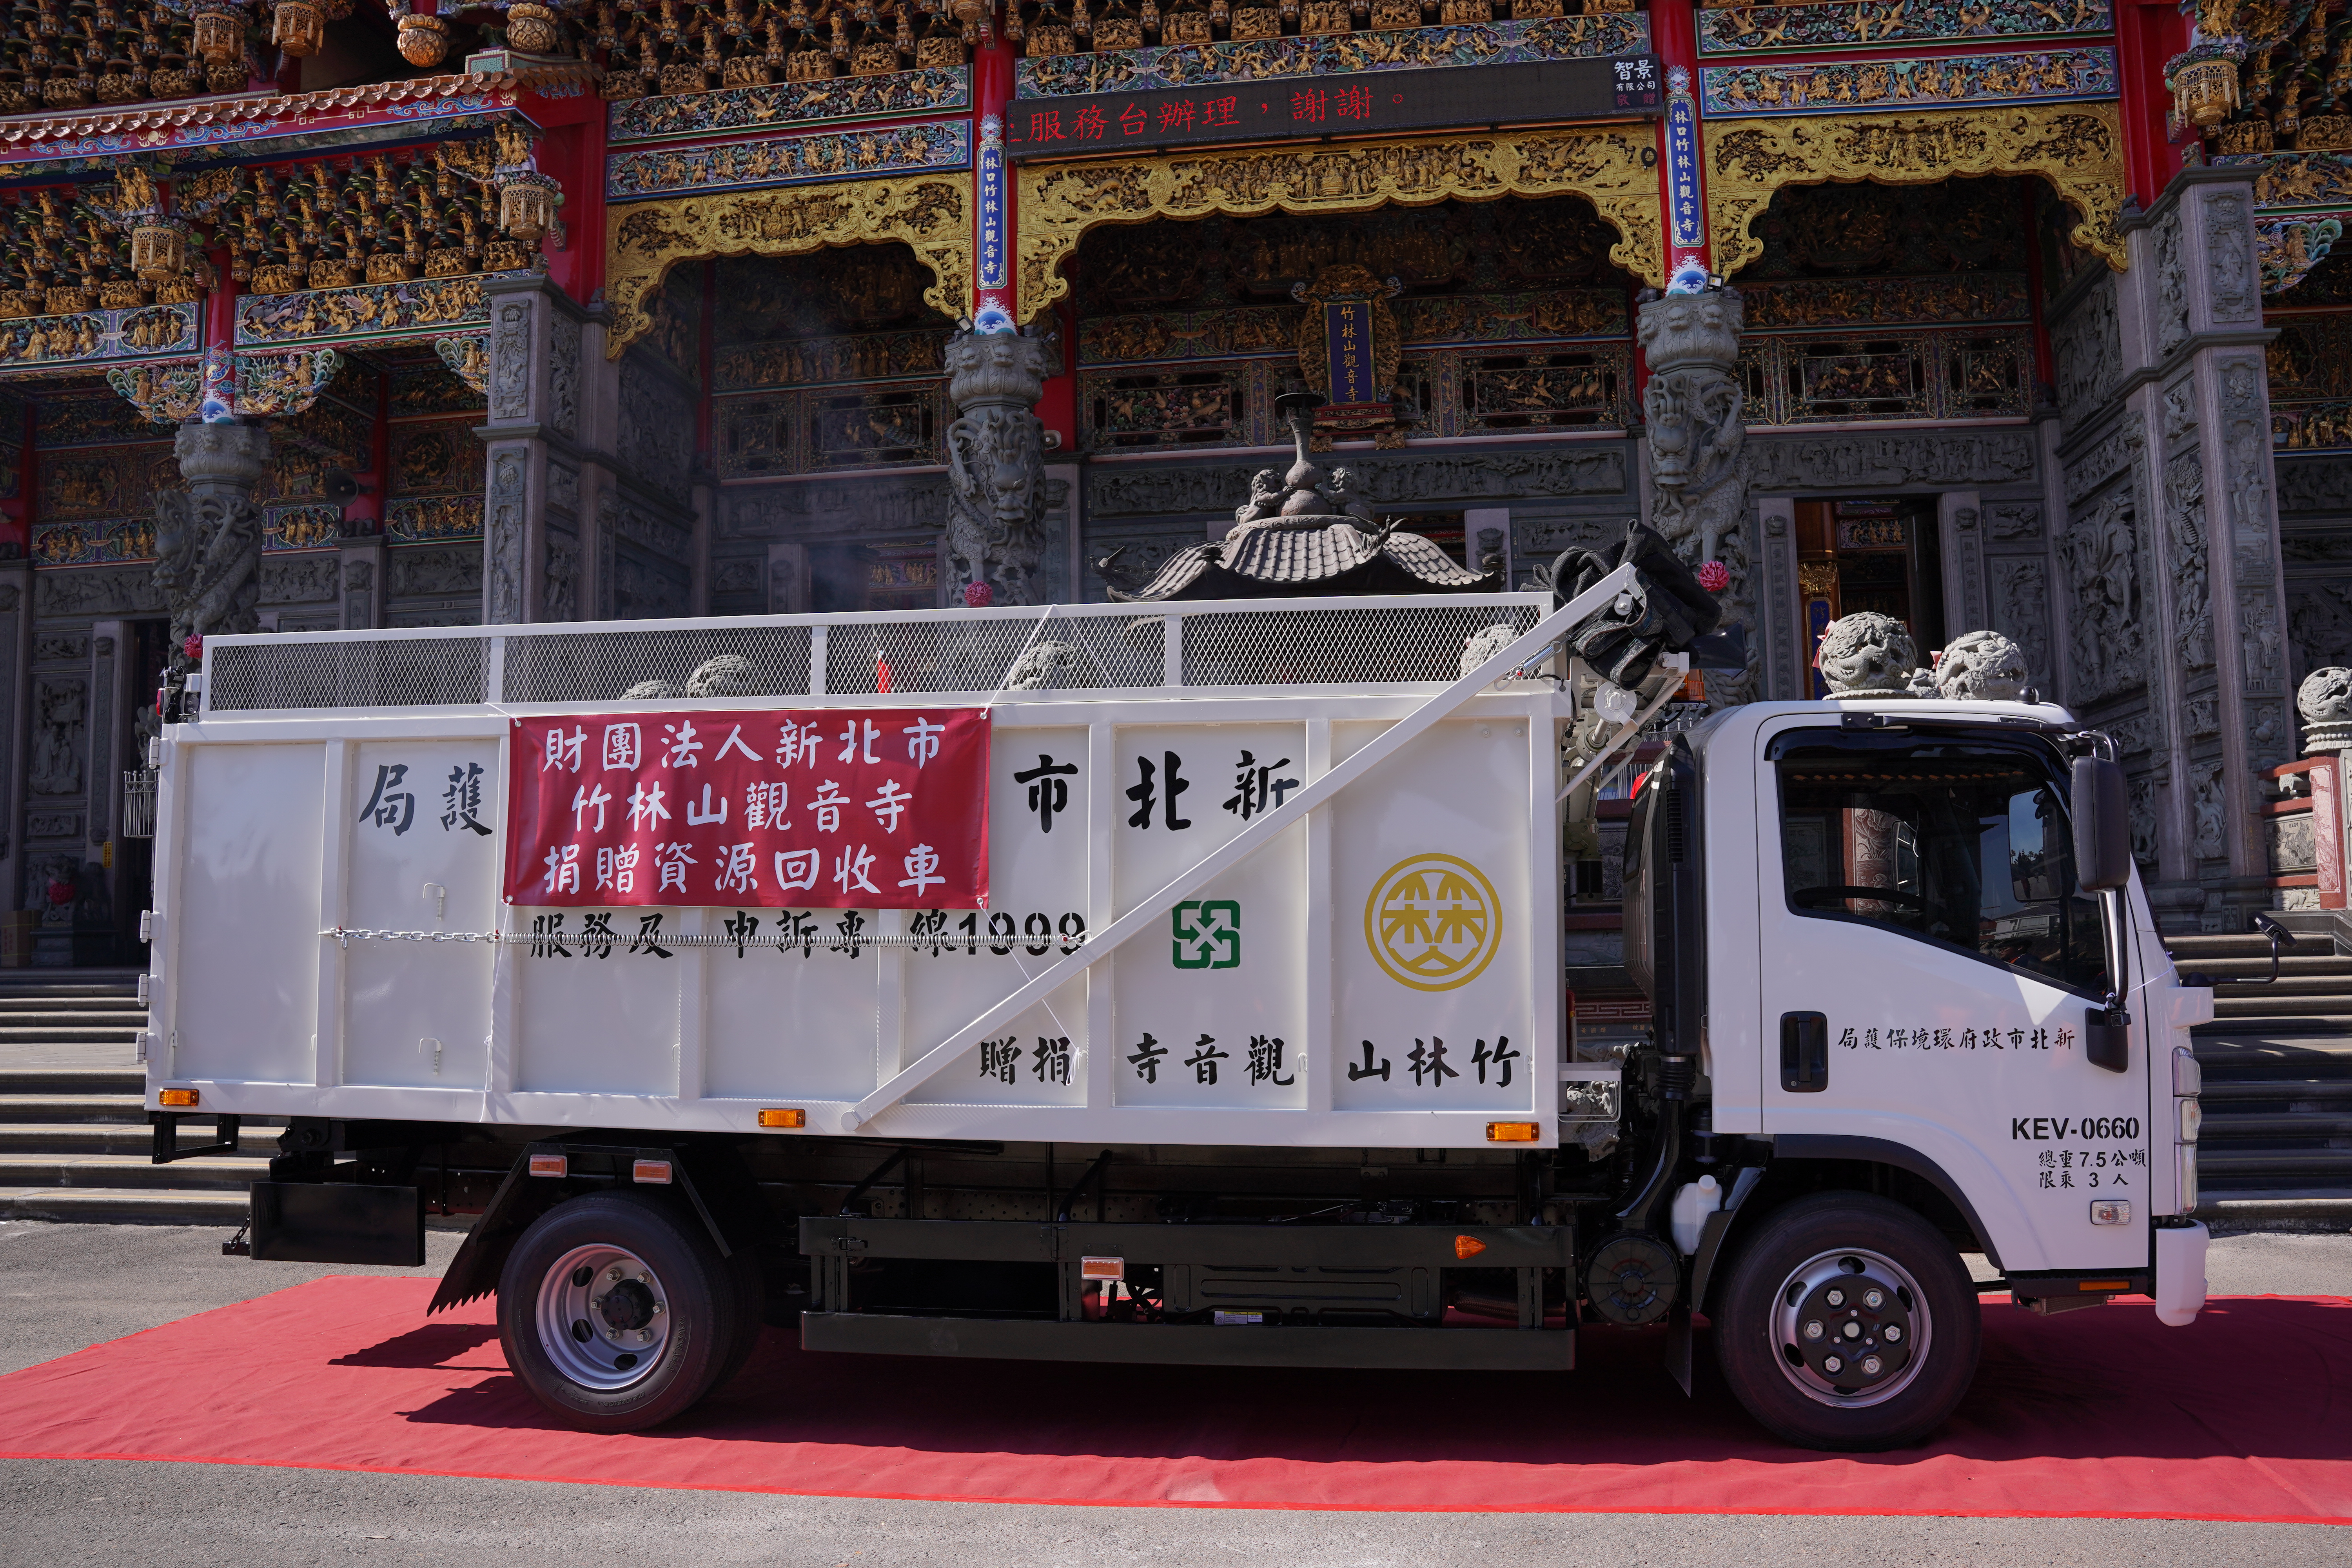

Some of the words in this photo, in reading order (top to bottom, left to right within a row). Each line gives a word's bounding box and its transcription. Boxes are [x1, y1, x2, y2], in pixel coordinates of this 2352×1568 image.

[1614, 59, 1654, 81] 智景
[1615, 80, 1656, 92] 有限公司
[1617, 92, 1656, 107] 敬贈
[1674, 110, 1695, 232] 林口竹林山觀音寺
[984, 157, 999, 274] 林口竹林山觀音寺
[1340, 305, 1359, 401] 竹林山觀音寺
[543, 717, 945, 773] 財團法人新北市
[572, 779, 913, 834] 竹林山觀音寺
[543, 842, 946, 898] 捐贈資源回收車
[2012, 1117, 2140, 1140] KEV-0660
[666, 1315, 686, 1373] YOKOHAMA
